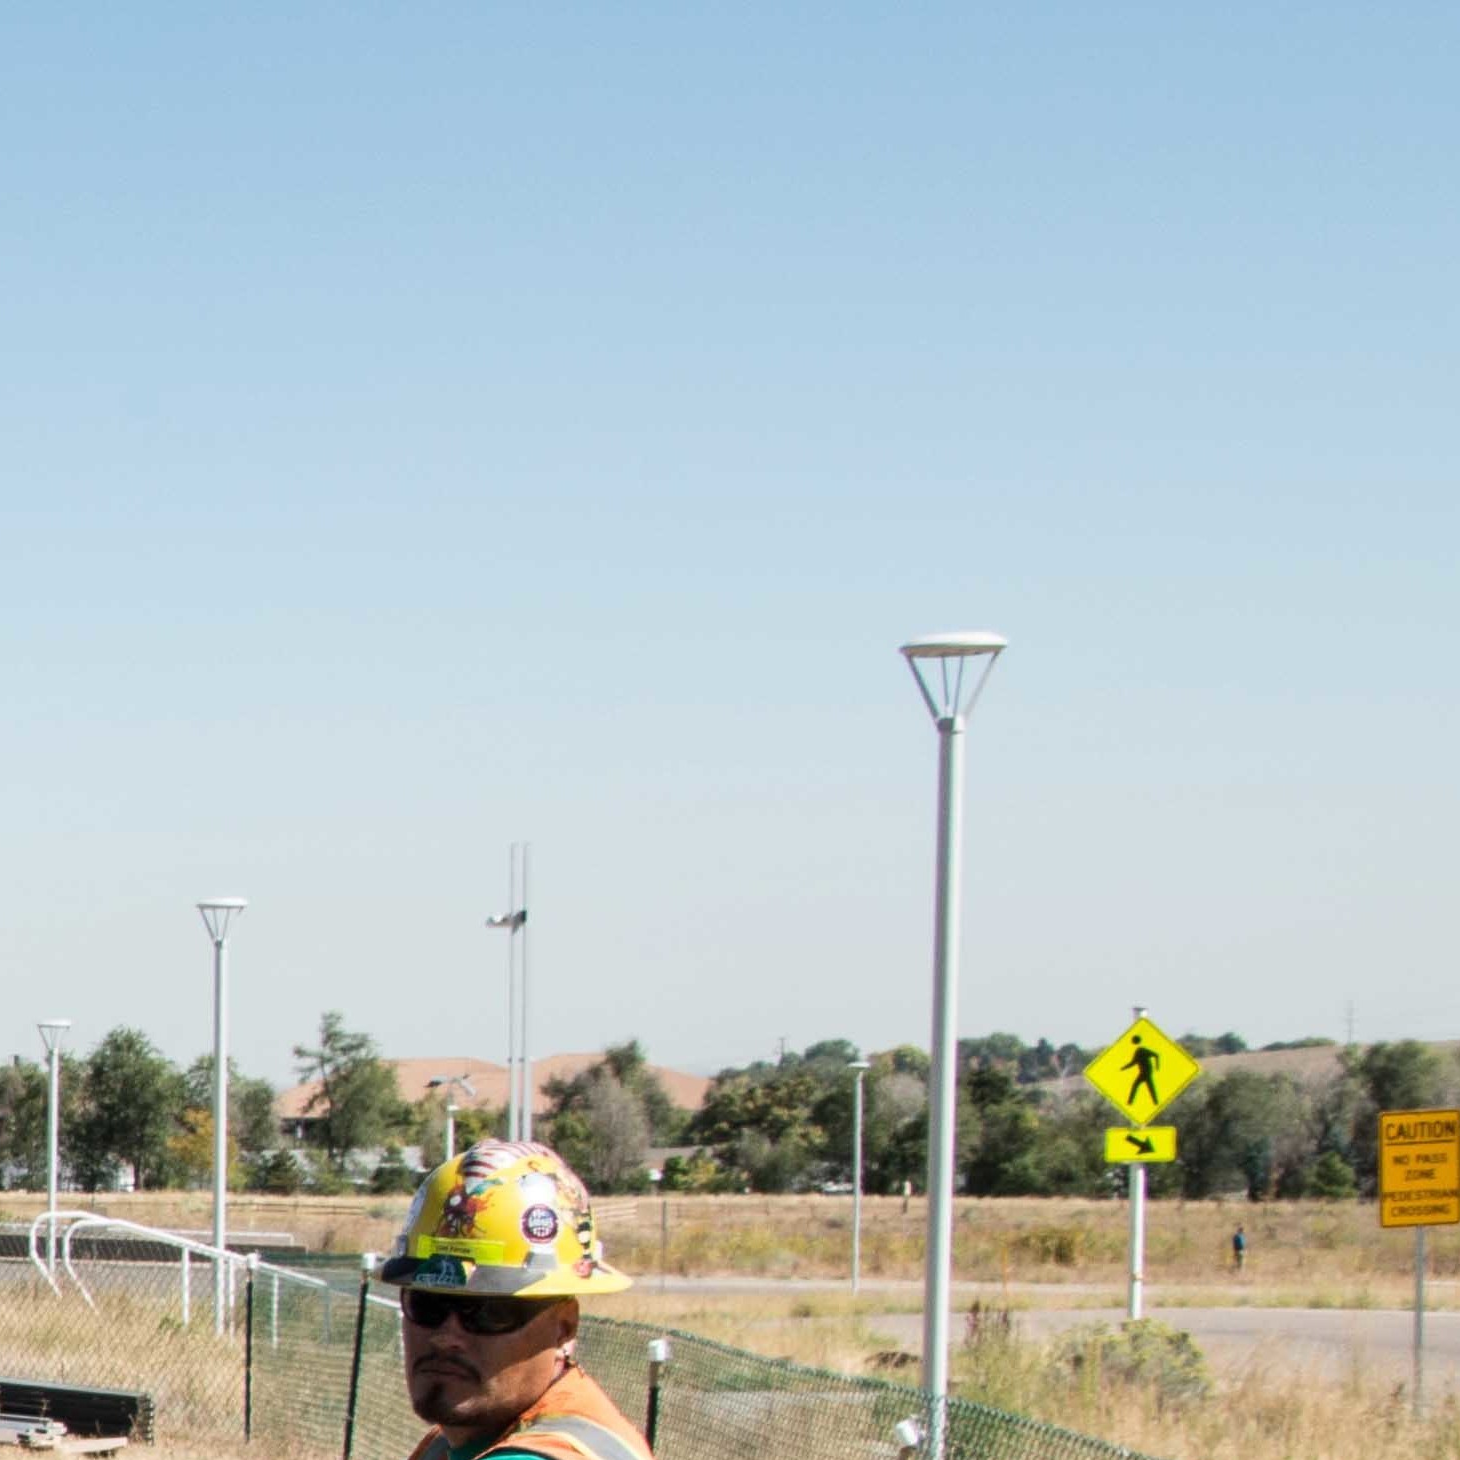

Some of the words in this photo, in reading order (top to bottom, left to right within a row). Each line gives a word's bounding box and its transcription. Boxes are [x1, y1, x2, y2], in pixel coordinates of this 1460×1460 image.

[1385, 1121, 1456, 1140] CAUTION
[1393, 1155, 1409, 1165] NO
[1405, 1169, 1435, 1181] ZONE
[1384, 1189, 1458, 1202] PEDESTRIAN
[1391, 1204, 1450, 1217] CROSSING
